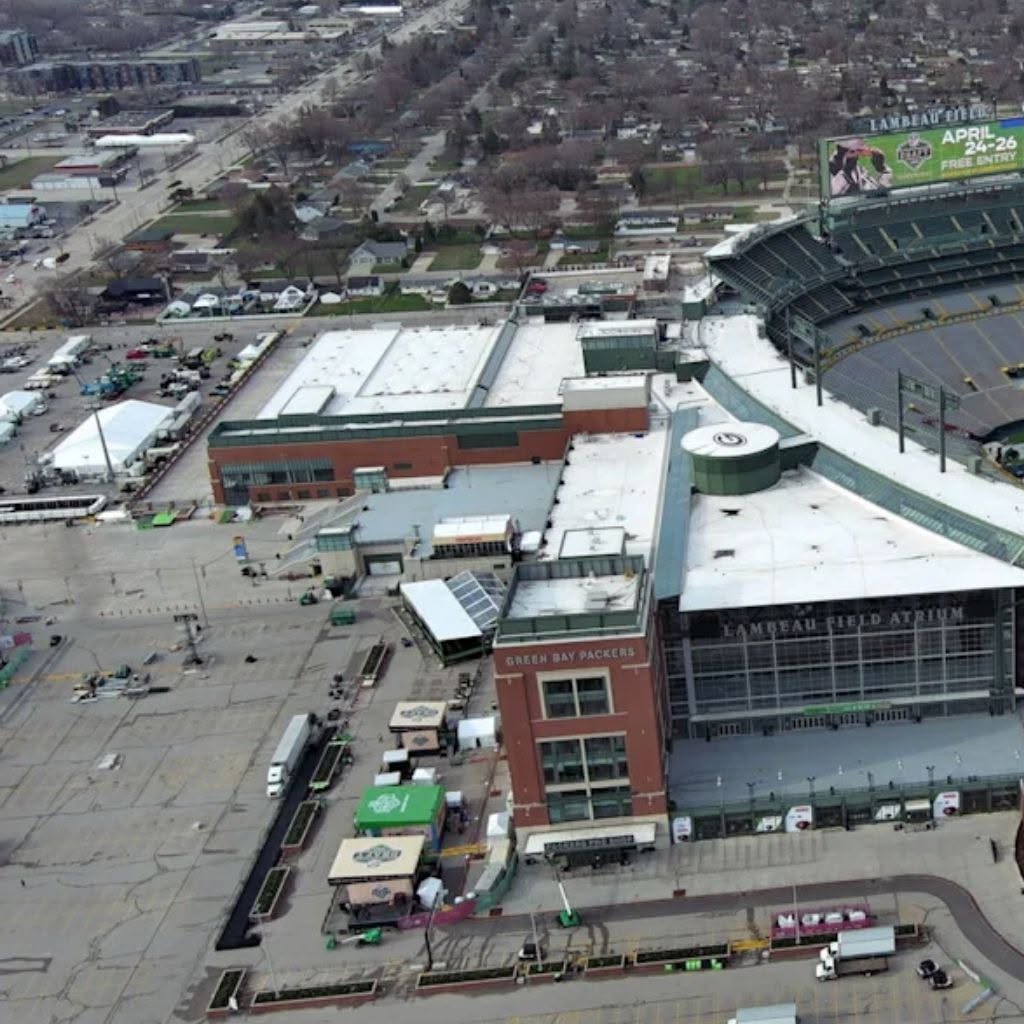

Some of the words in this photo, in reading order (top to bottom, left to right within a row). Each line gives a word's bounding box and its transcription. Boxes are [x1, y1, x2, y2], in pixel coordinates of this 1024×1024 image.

[870, 111, 939, 131] LAMBEAU
[942, 126, 995, 145] APRIL
[964, 137, 1017, 156] 24-26
[941, 157, 974, 171] FREE
[977, 151, 1017, 166] ENTRY
[723, 619, 816, 637] LAMBEAU
[827, 613, 881, 630] FIELD
[890, 607, 964, 625] ATRIUM
[506, 655, 547, 667] GREEN
[553, 651, 576, 662] BAY
[579, 647, 635, 660] PACKERS
